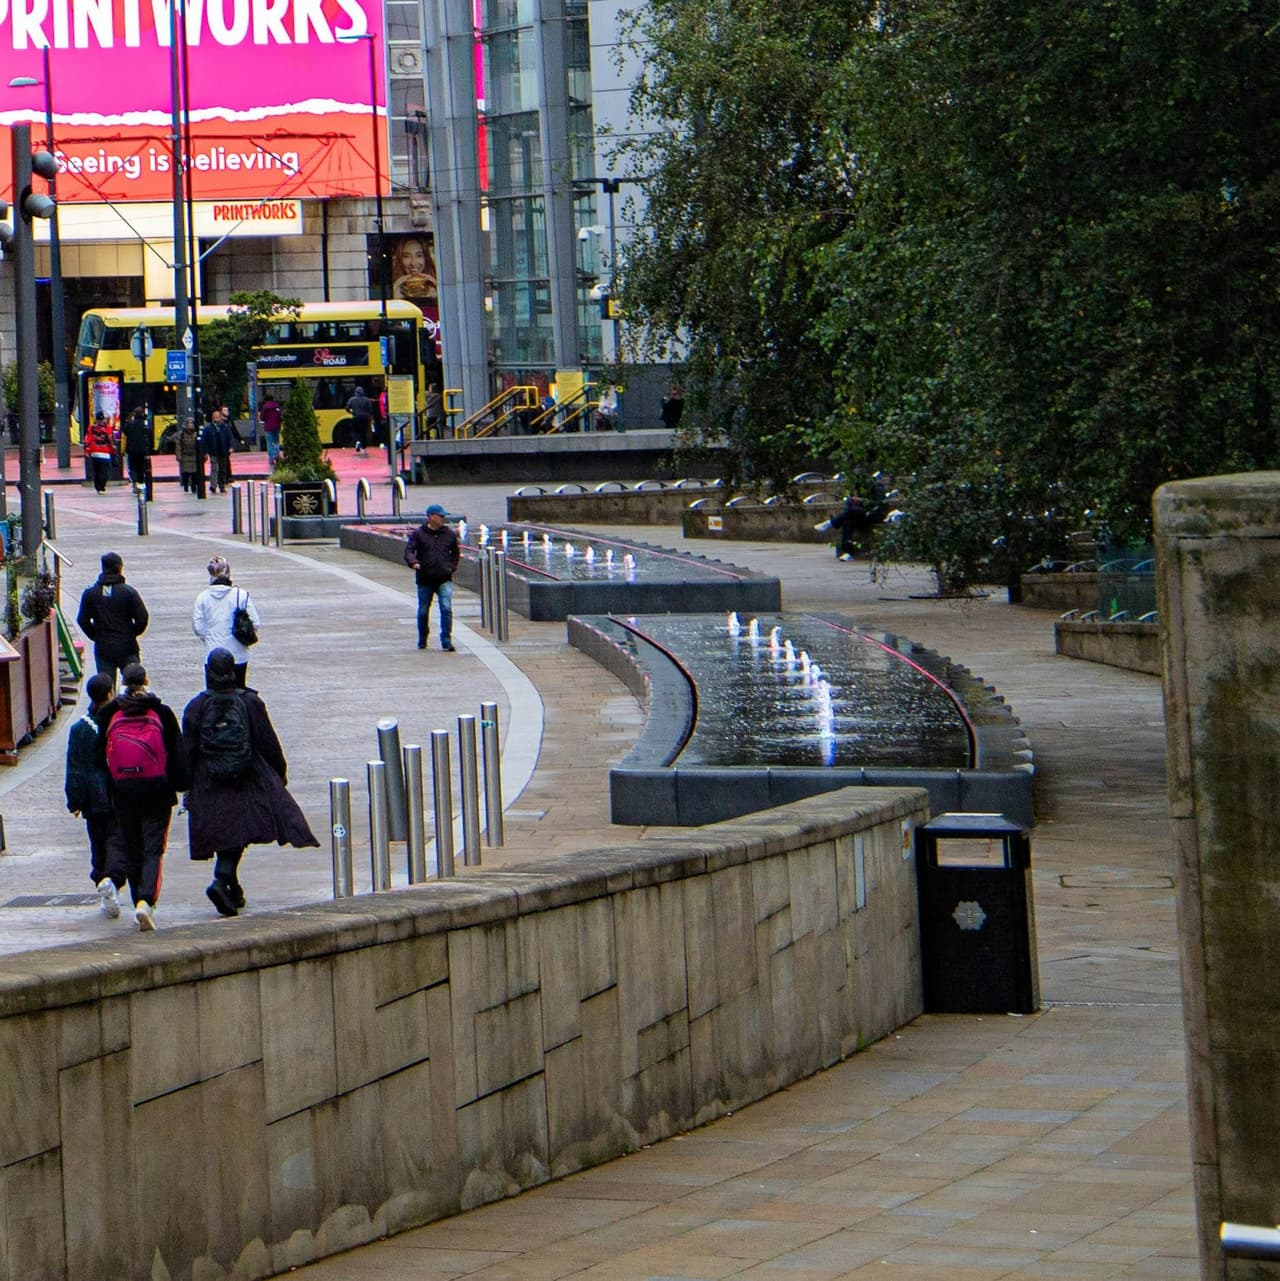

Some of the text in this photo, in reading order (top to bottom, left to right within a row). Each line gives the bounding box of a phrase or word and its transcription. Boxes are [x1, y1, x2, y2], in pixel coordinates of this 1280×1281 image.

[52, 150, 141, 179] Seeing
[150, 148, 170, 171] is
[213, 202, 297, 221] PRINTWORKS
